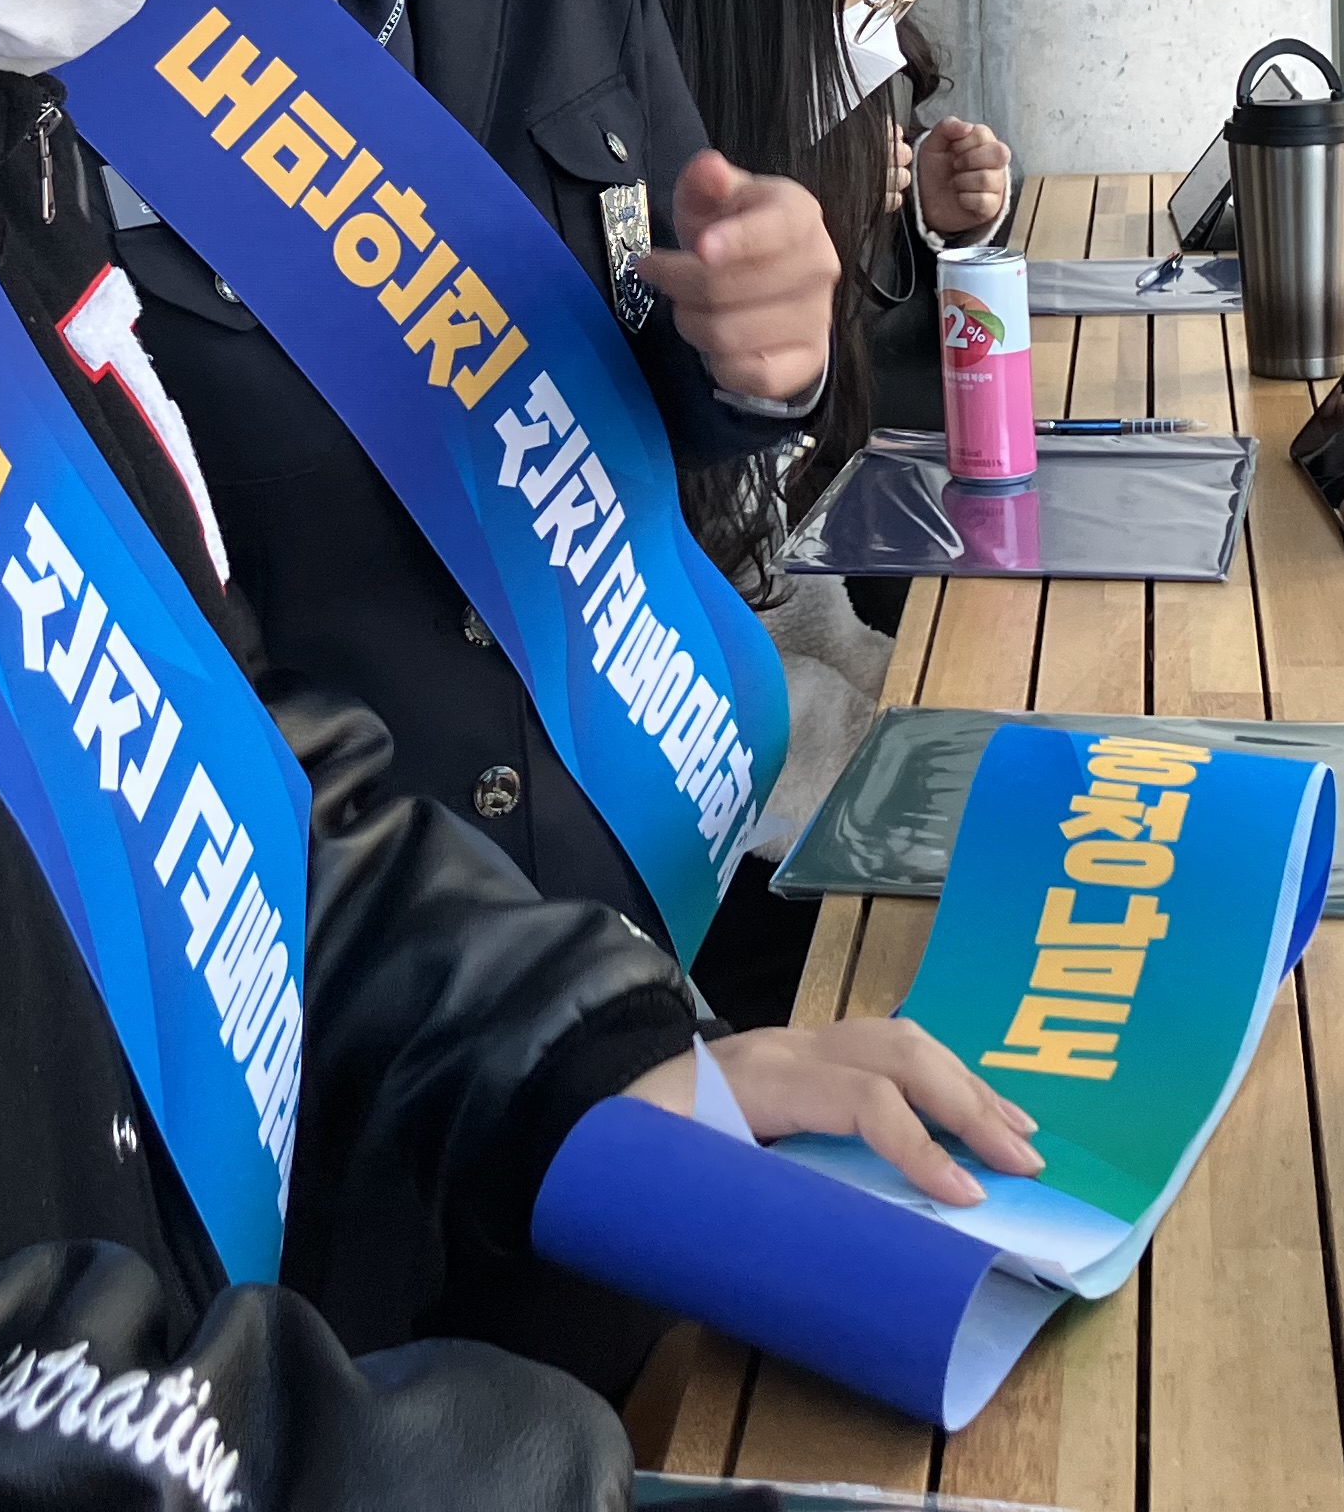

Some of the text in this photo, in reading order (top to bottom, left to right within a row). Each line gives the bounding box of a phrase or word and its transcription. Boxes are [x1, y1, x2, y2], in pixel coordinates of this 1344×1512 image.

[155, 6, 530, 410] 도민안전
[493, 369, 627, 586] 선진
[944, 303, 987, 350] 2%
[1, 502, 183, 823] 선진
